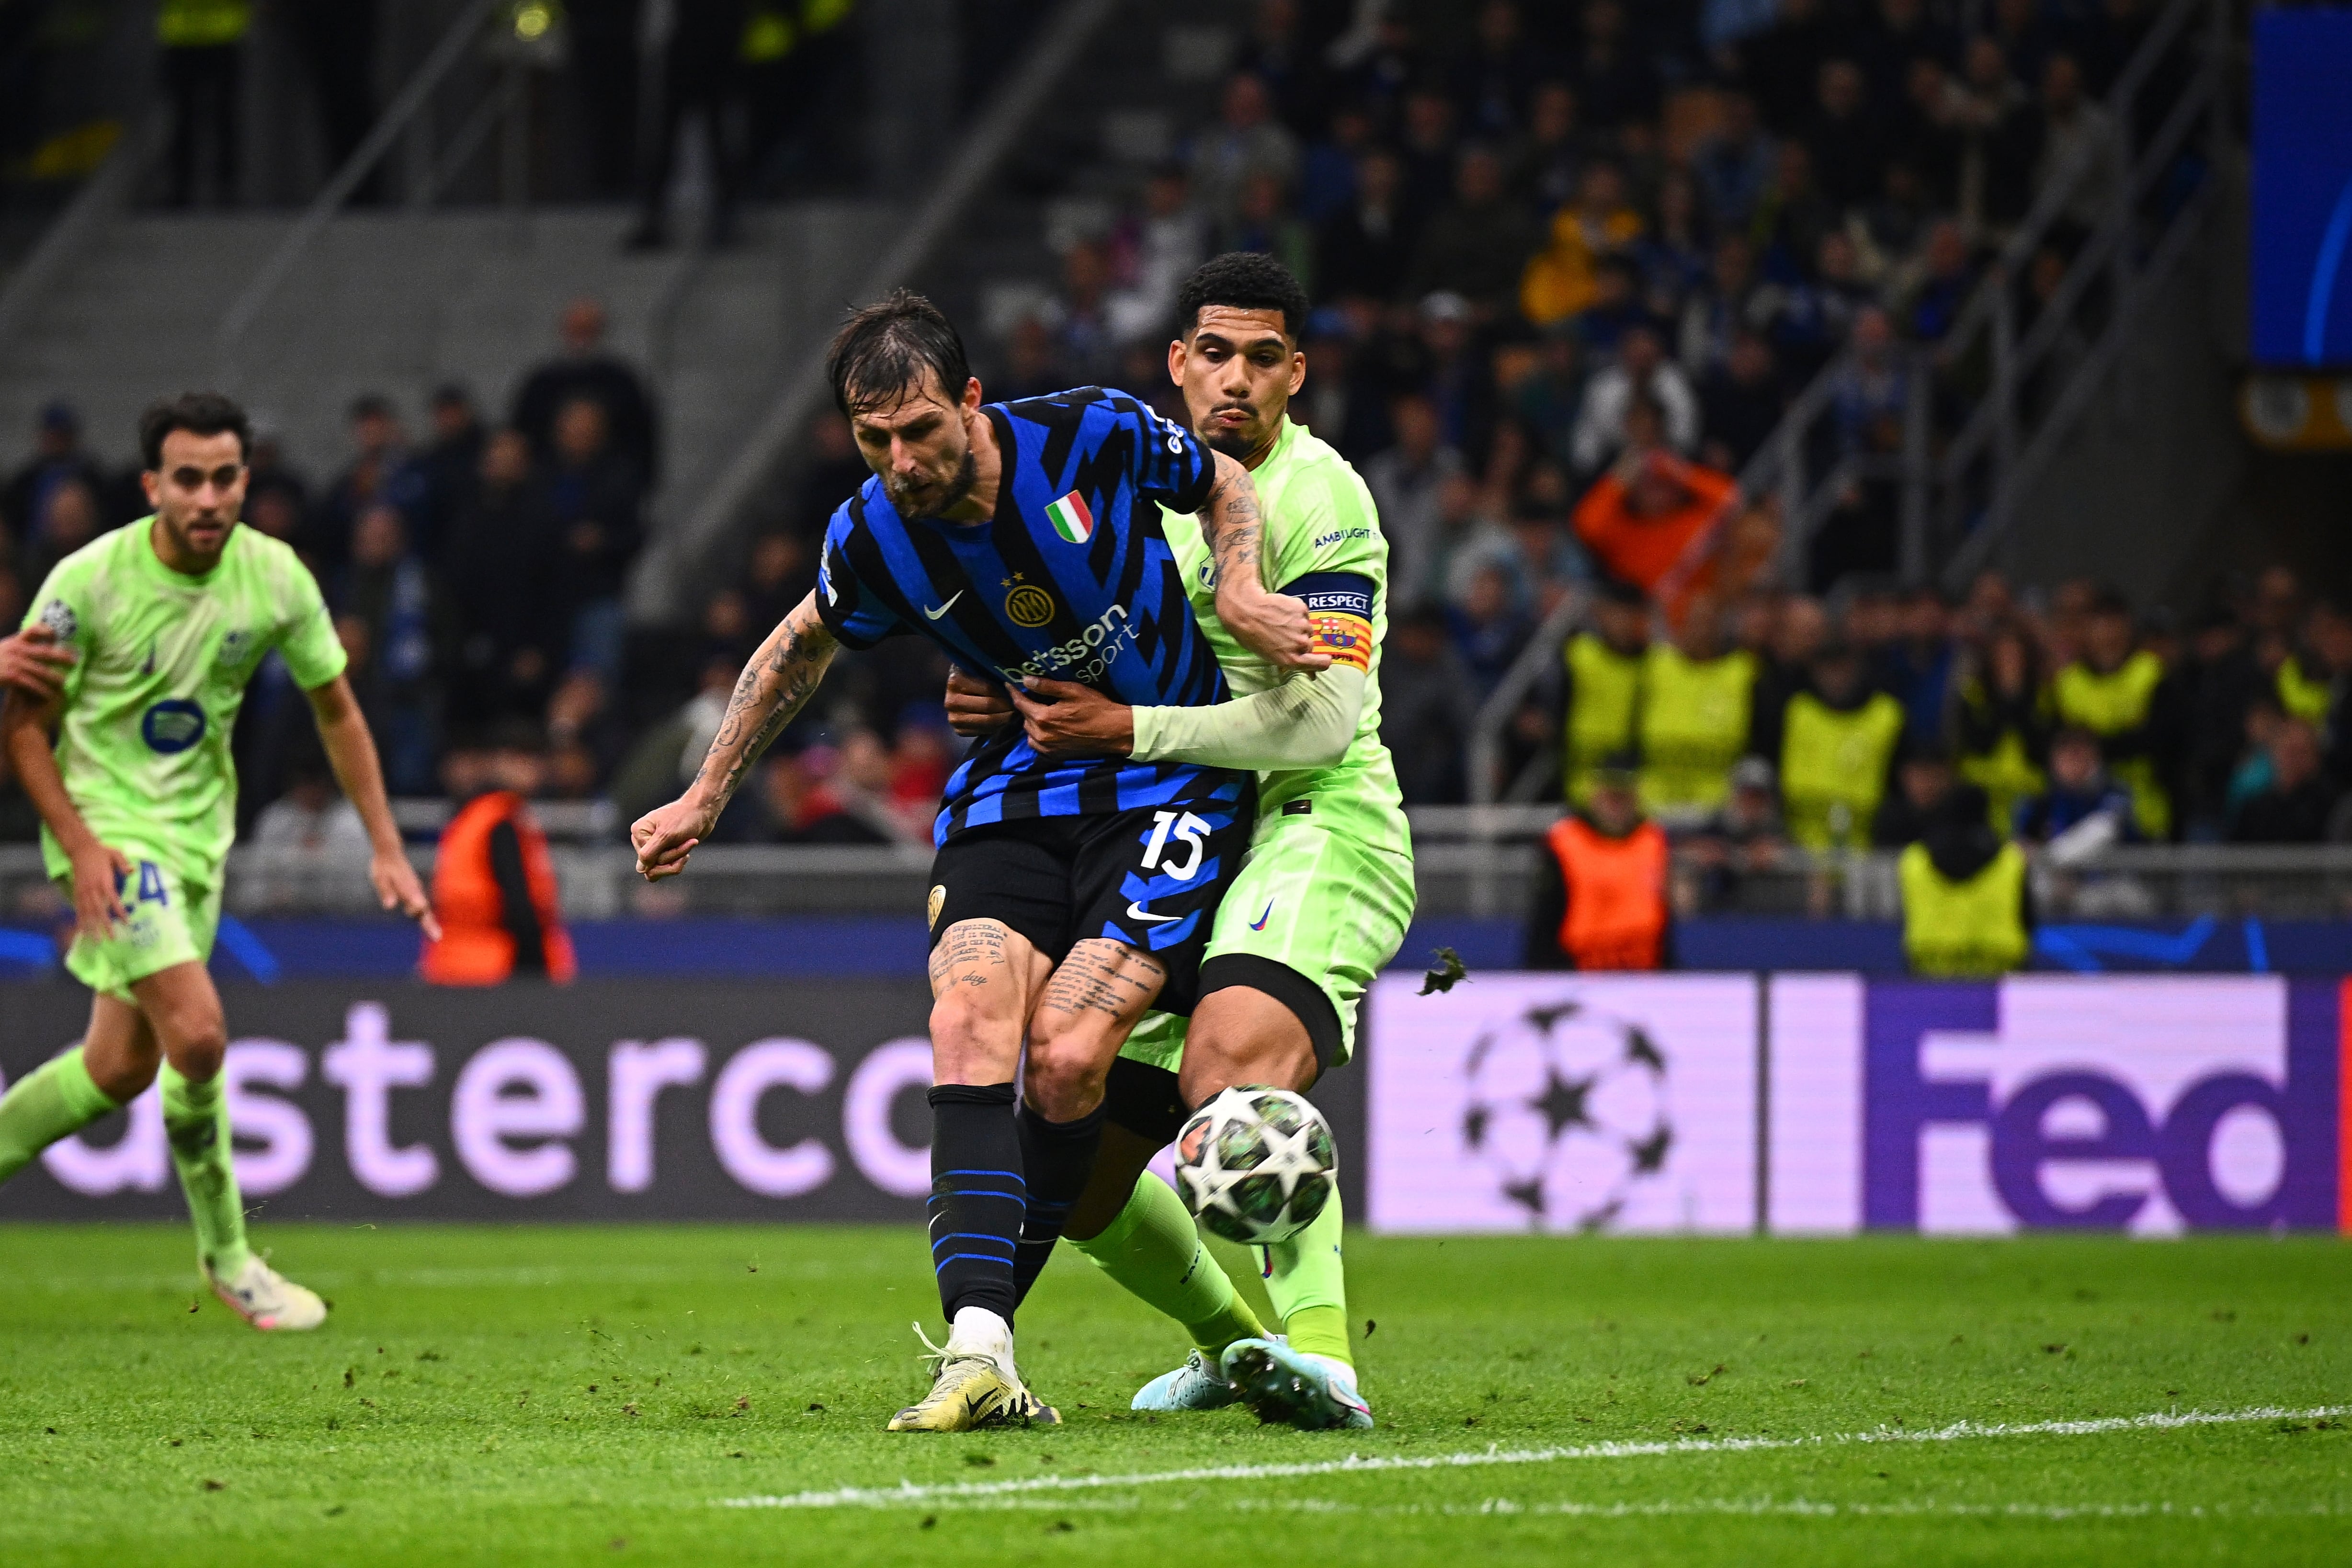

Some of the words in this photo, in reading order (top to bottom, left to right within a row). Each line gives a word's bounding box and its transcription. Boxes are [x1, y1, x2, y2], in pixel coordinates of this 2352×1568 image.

[1315, 527, 1371, 548] AMBILIGHT
[1308, 595, 1368, 610] RESPECT
[994, 604, 1128, 683] betsson
[1076, 624, 1140, 683] sport
[1140, 810, 1212, 881] 15
[962, 970, 988, 986] day
[1862, 979, 2352, 1231] Fed
